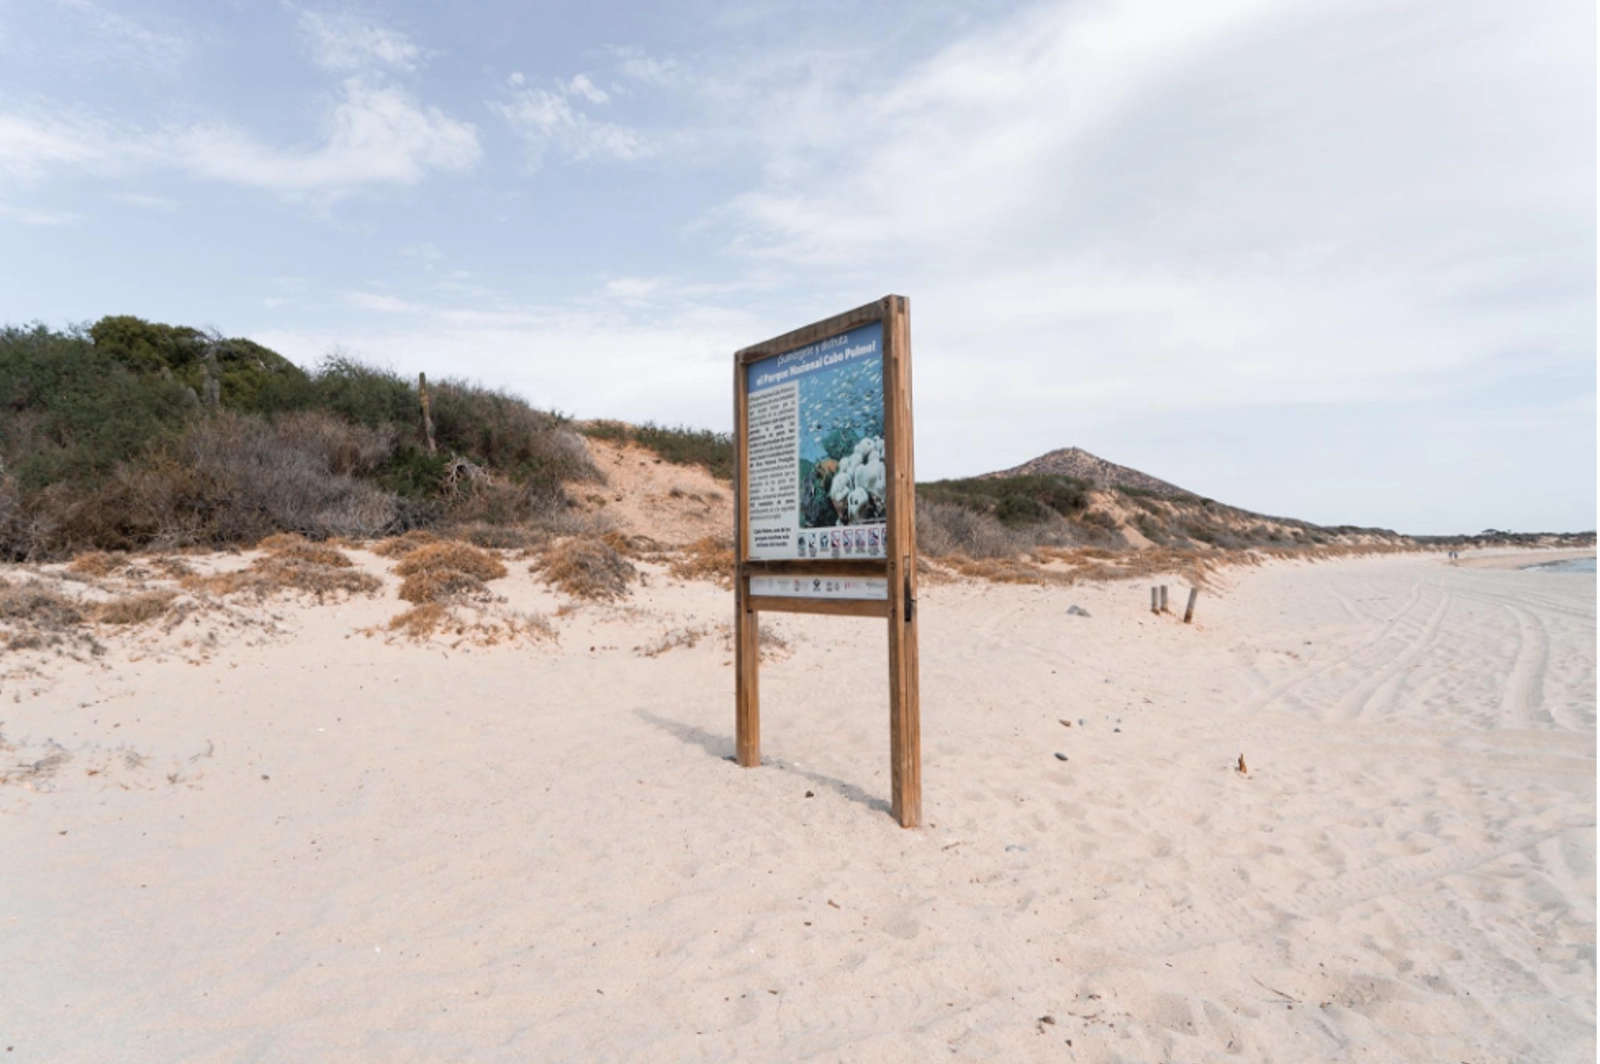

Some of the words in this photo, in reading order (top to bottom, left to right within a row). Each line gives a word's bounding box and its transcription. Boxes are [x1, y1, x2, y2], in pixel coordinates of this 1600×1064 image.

[764, 370, 788, 383] Parque
[789, 358, 822, 376] Nacional
[823, 353, 844, 366] Cabo
[844, 340, 876, 360] Pulmo!
